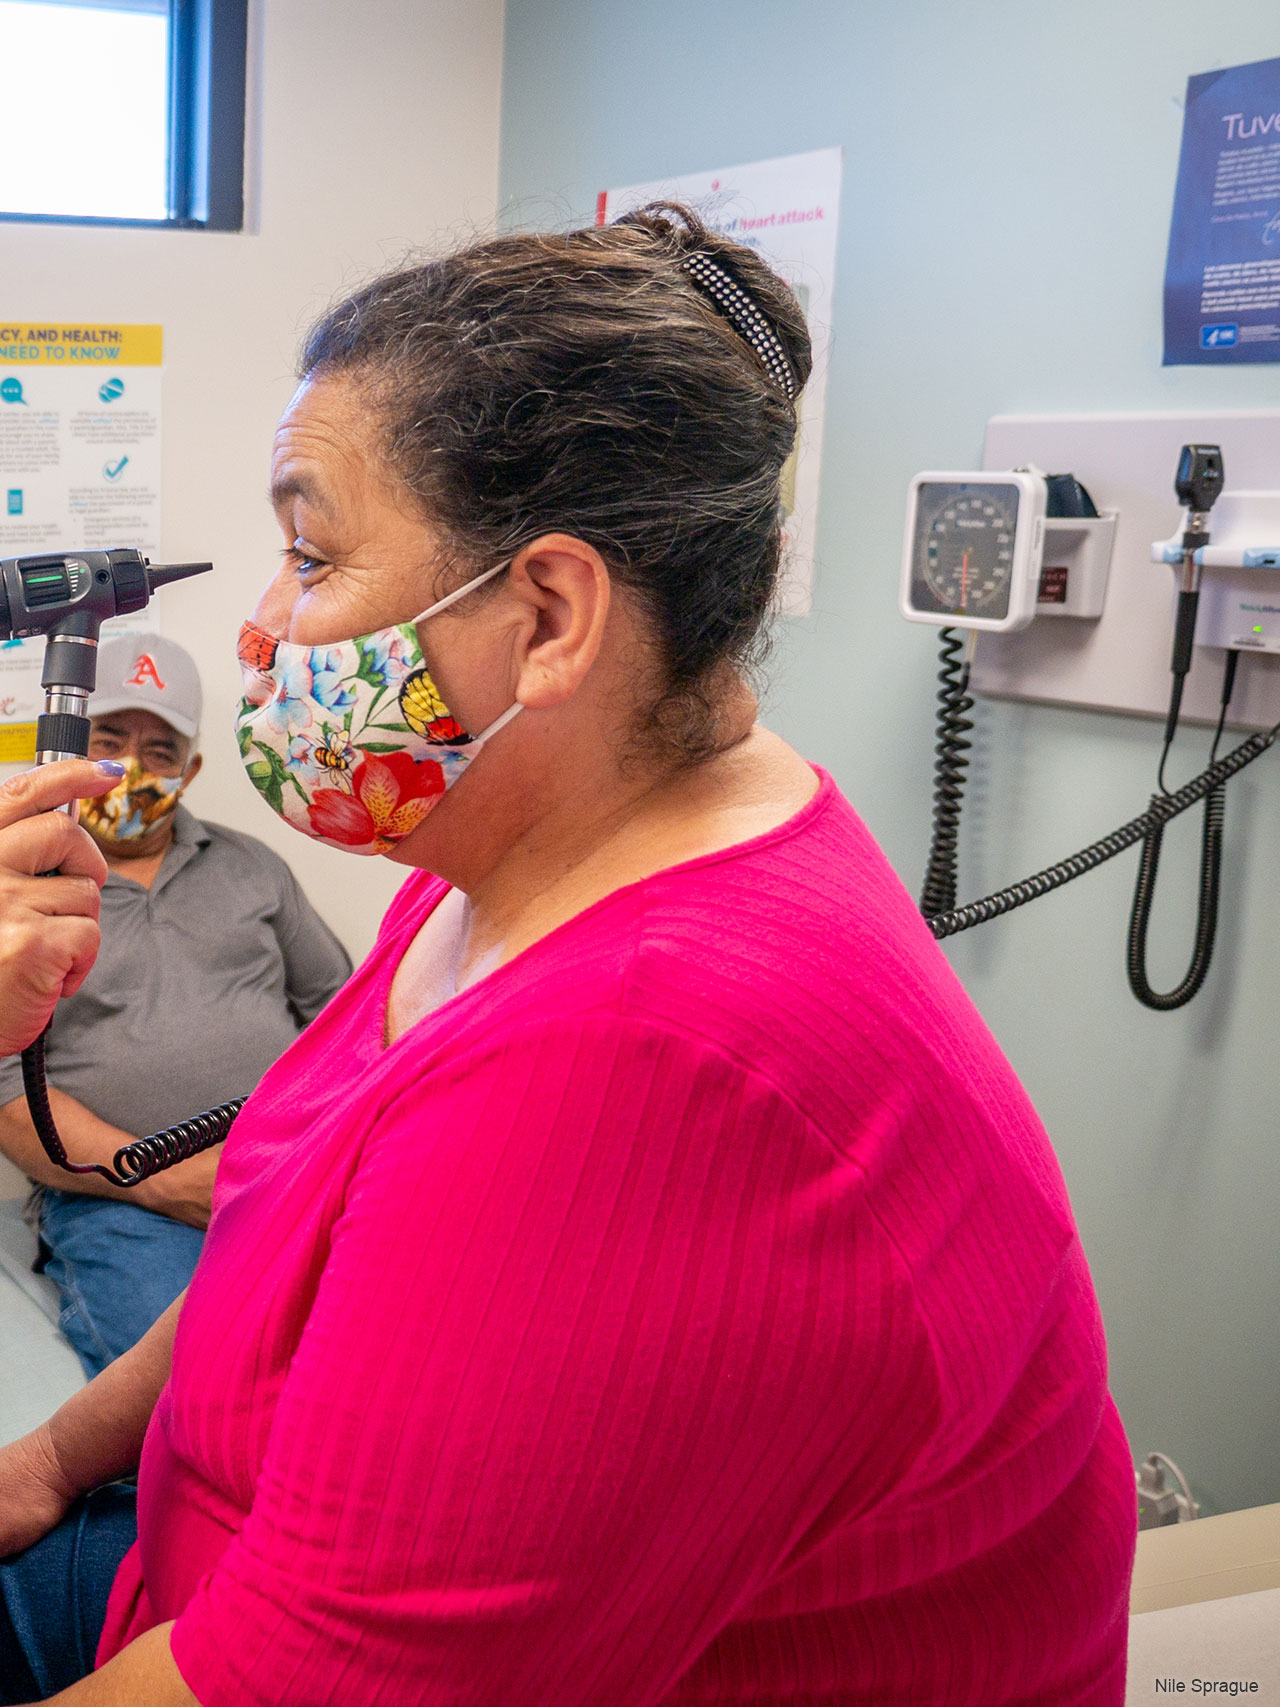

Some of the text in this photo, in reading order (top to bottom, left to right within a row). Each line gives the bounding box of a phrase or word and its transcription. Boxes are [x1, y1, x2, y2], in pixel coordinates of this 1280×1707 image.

[740, 213, 776, 231] heart
[778, 205, 824, 225] attack
[27, 329, 59, 342] AND
[63, 330, 122, 343] HEALTH:
[45, 346, 65, 360] TO
[69, 346, 120, 360] KNOW
[125, 653, 166, 691] A
